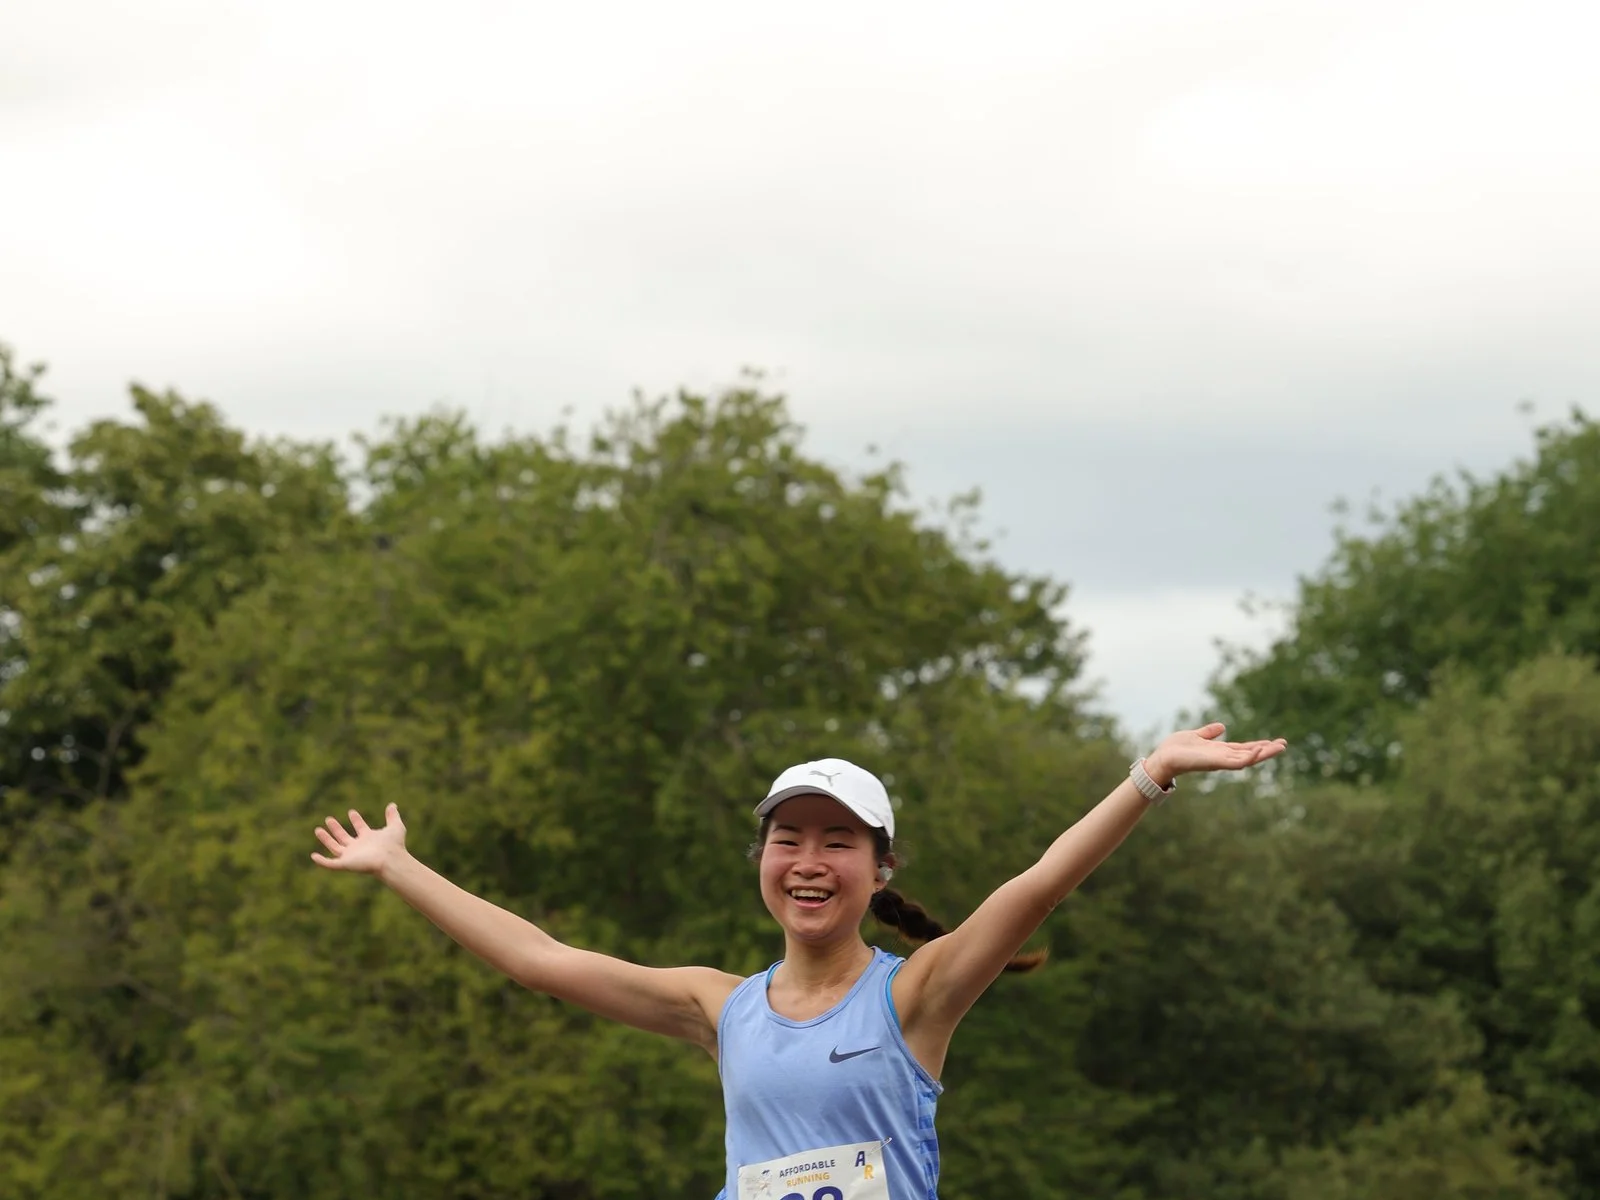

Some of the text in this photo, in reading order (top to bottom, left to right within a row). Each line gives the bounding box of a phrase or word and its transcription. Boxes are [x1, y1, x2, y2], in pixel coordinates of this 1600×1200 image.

[854, 1151, 866, 1167] A
[779, 1159, 836, 1178] AFFORDABLE
[864, 1164, 874, 1180] R
[786, 1172, 830, 1188] RUNNING
